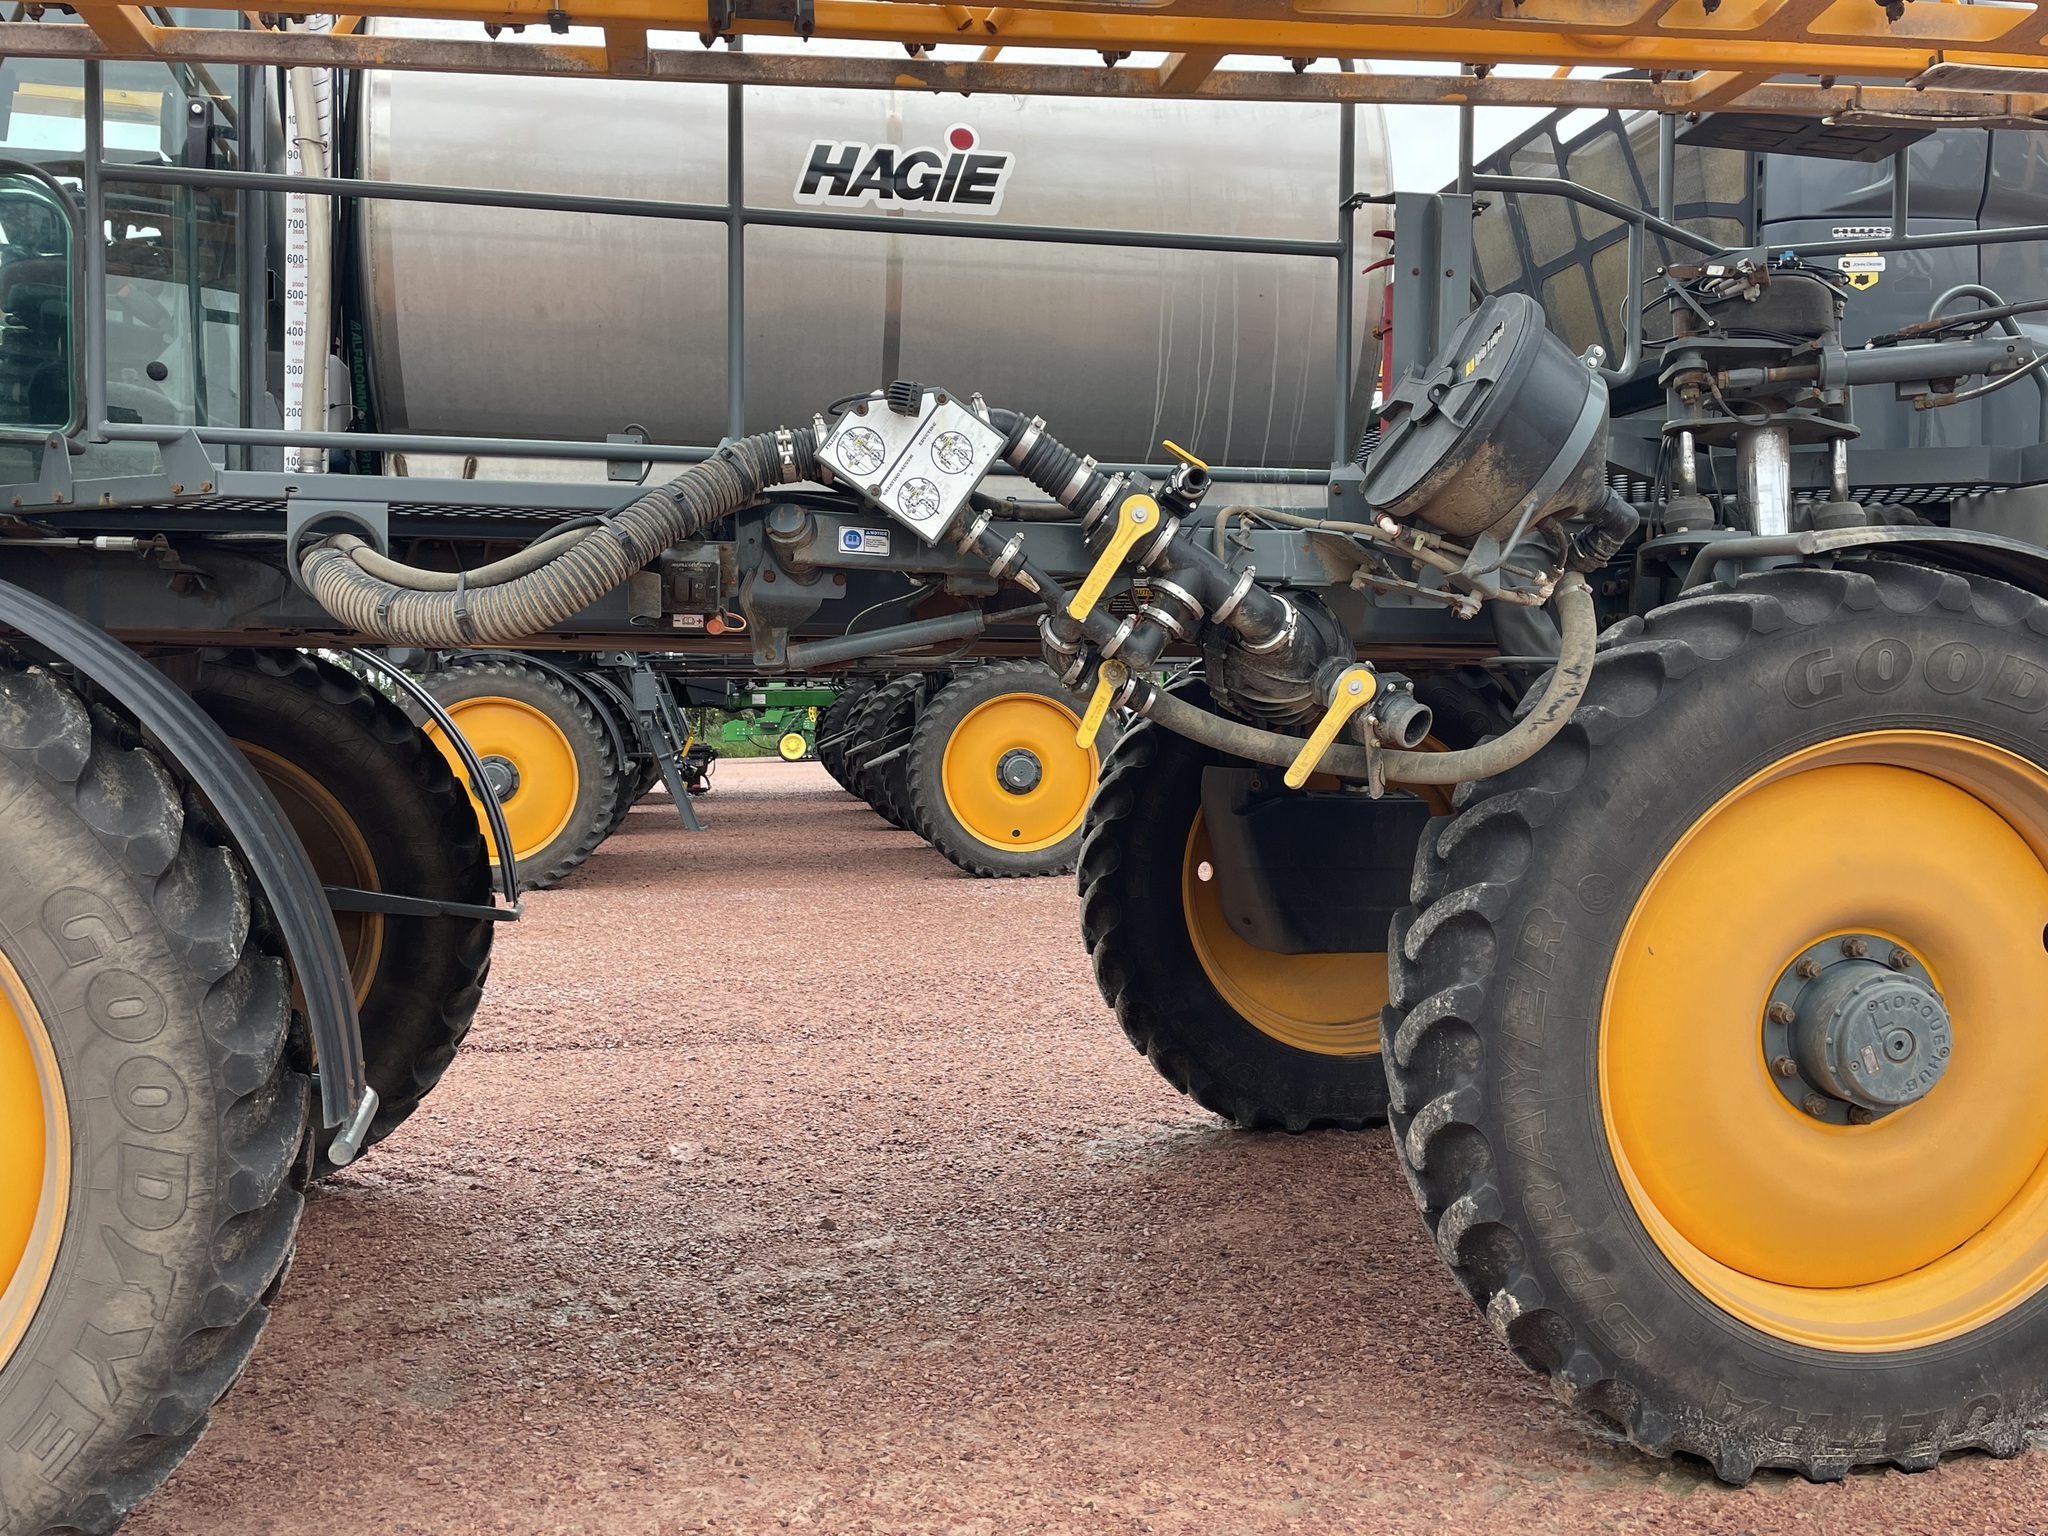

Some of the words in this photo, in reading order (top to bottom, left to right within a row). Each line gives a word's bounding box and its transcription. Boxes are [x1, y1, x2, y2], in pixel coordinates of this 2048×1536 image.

[799, 128, 1008, 205] HAGIE
[287, 219, 304, 229] 700
[287, 253, 304, 264] 600
[286, 289, 304, 300] 500
[286, 326, 304, 337] 400
[286, 365, 303, 375] 300
[286, 407, 303, 417] 200
[1500, 907, 1657, 1360] SPRAYER
